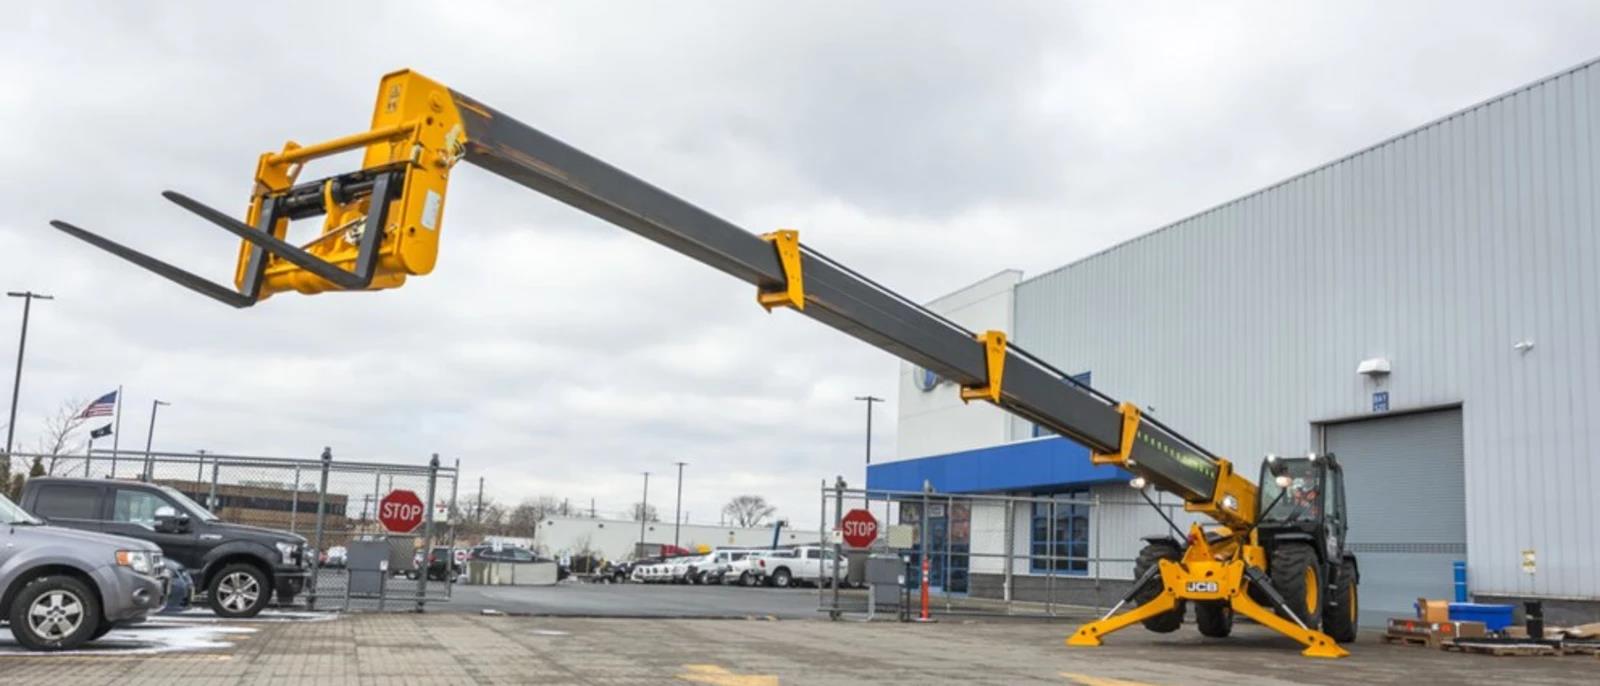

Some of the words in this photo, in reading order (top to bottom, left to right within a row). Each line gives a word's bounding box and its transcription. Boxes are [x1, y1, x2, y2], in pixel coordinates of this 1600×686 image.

[384, 503, 420, 520] STOP
[845, 521, 875, 537] STOP
[1187, 583, 1217, 592] JCB
